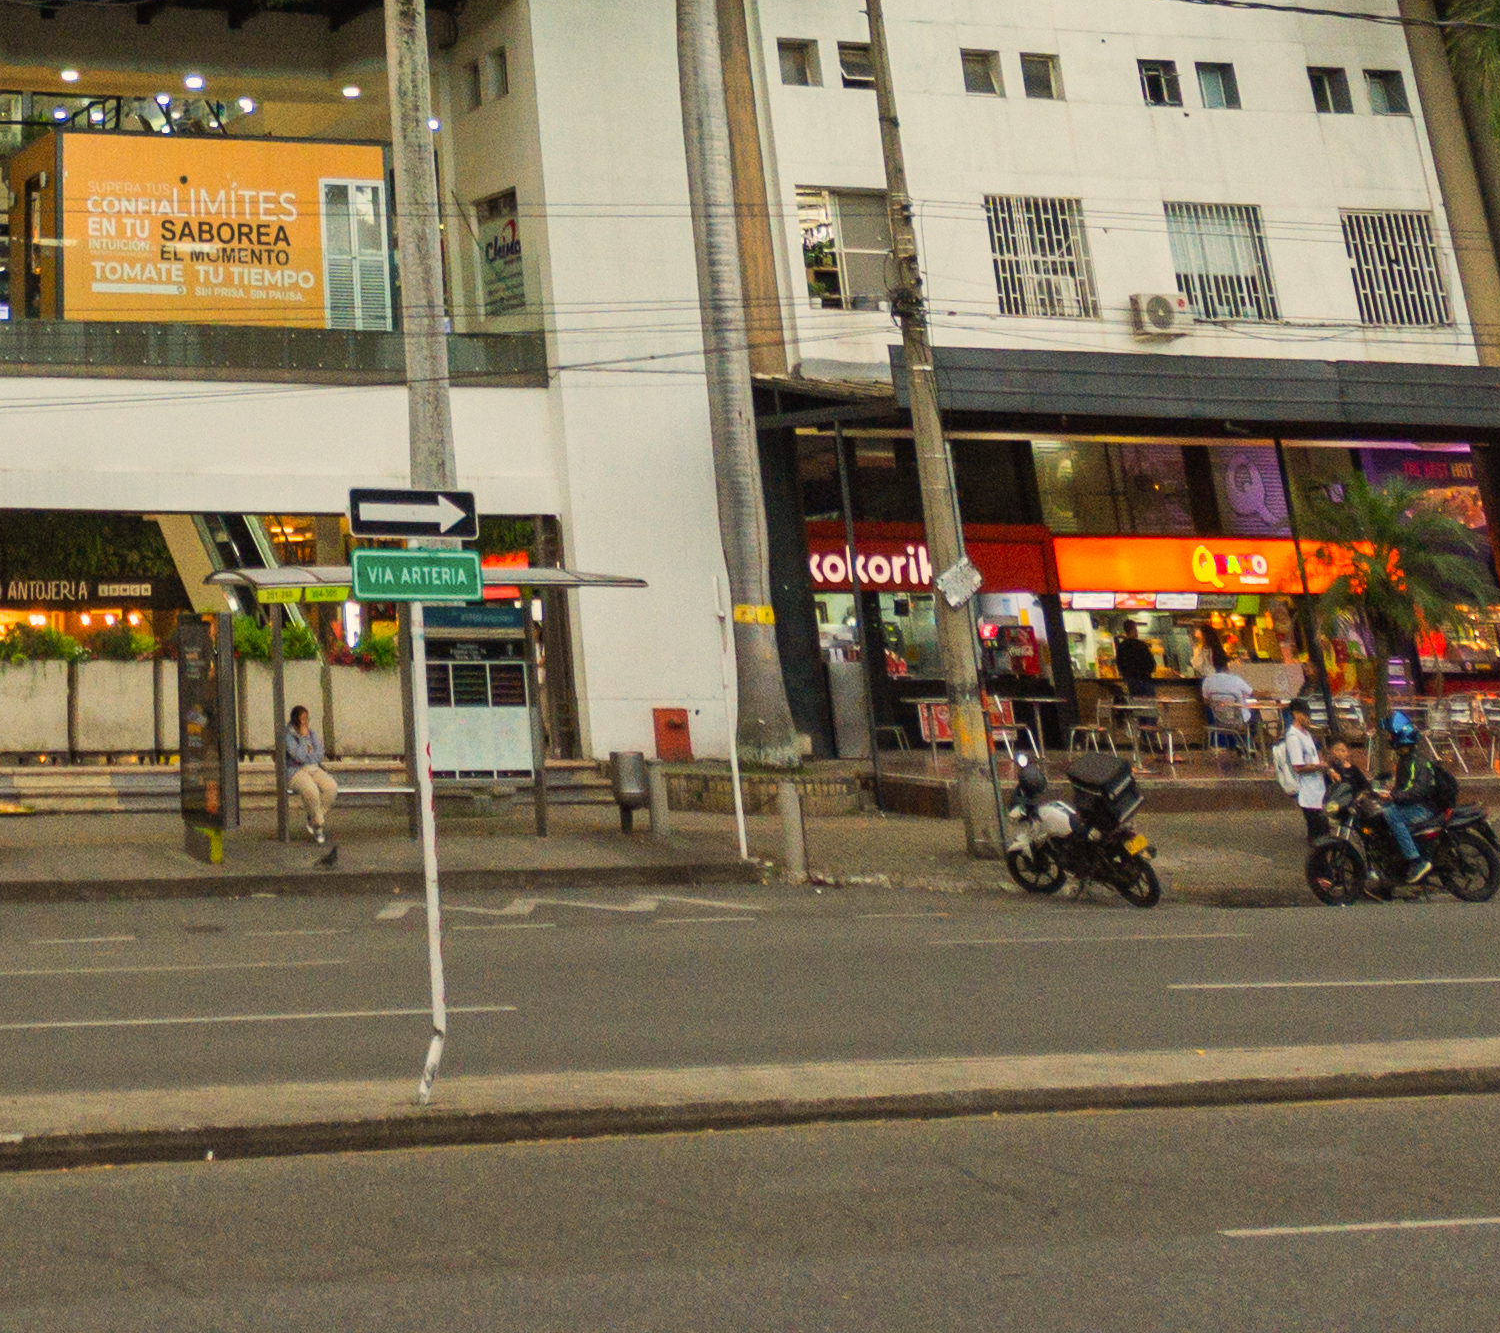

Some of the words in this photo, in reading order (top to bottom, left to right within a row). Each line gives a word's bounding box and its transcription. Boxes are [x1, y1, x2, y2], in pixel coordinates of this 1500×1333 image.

[87, 181, 142, 194] SUPERA
[147, 183, 171, 195] TUS
[86, 195, 173, 216] CONFIA
[87, 217, 116, 237] EN
[121, 218, 150, 238] TU
[160, 219, 291, 247] SABOREA
[160, 244, 184, 262] EL
[190, 246, 290, 266] MOMENTO
[91, 261, 185, 283] TOMATE
[194, 264, 224, 284] TU
[229, 266, 315, 289] TIEMPO
[194, 286, 212, 298] SIN
[250, 288, 267, 300] SIN
[1451, 462, 1475, 480] HOT
[366, 565, 395, 585] VIA
[400, 566, 469, 586] ARTERIA
[809, 544, 933, 586] kokorik
